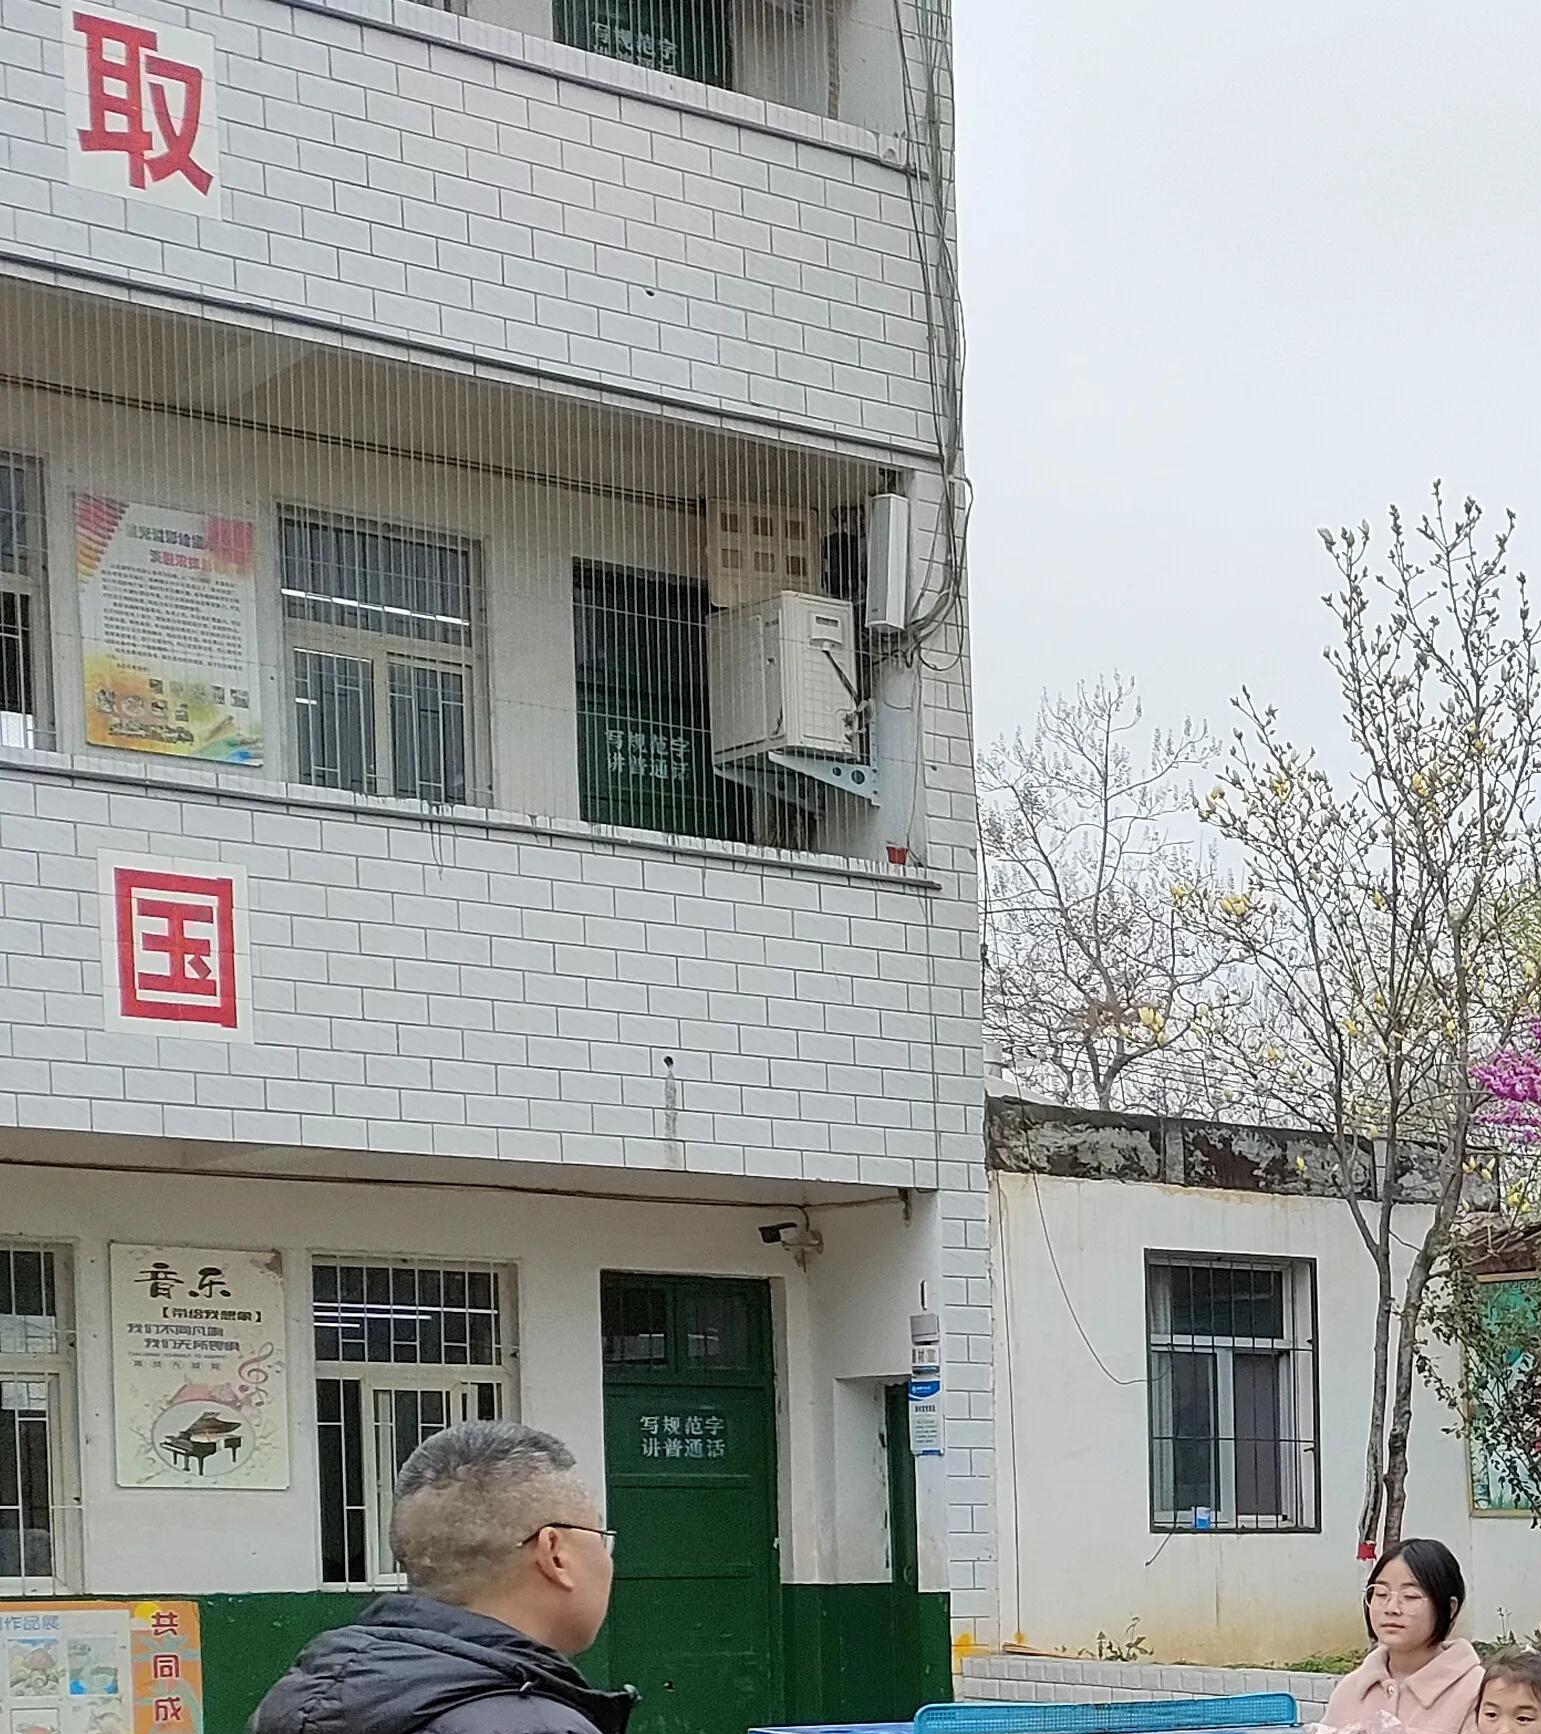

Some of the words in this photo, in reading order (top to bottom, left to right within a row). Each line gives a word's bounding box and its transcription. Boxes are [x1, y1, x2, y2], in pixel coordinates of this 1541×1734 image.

[72, 11, 213, 196] 取
[113, 867, 240, 1029] 国
[134, 1262, 232, 1299] 音乐
[640, 1415, 724, 1436] 写规范字
[641, 1437, 726, 1458] 讲普通话
[0, 1615, 60, 1631] 作品展
